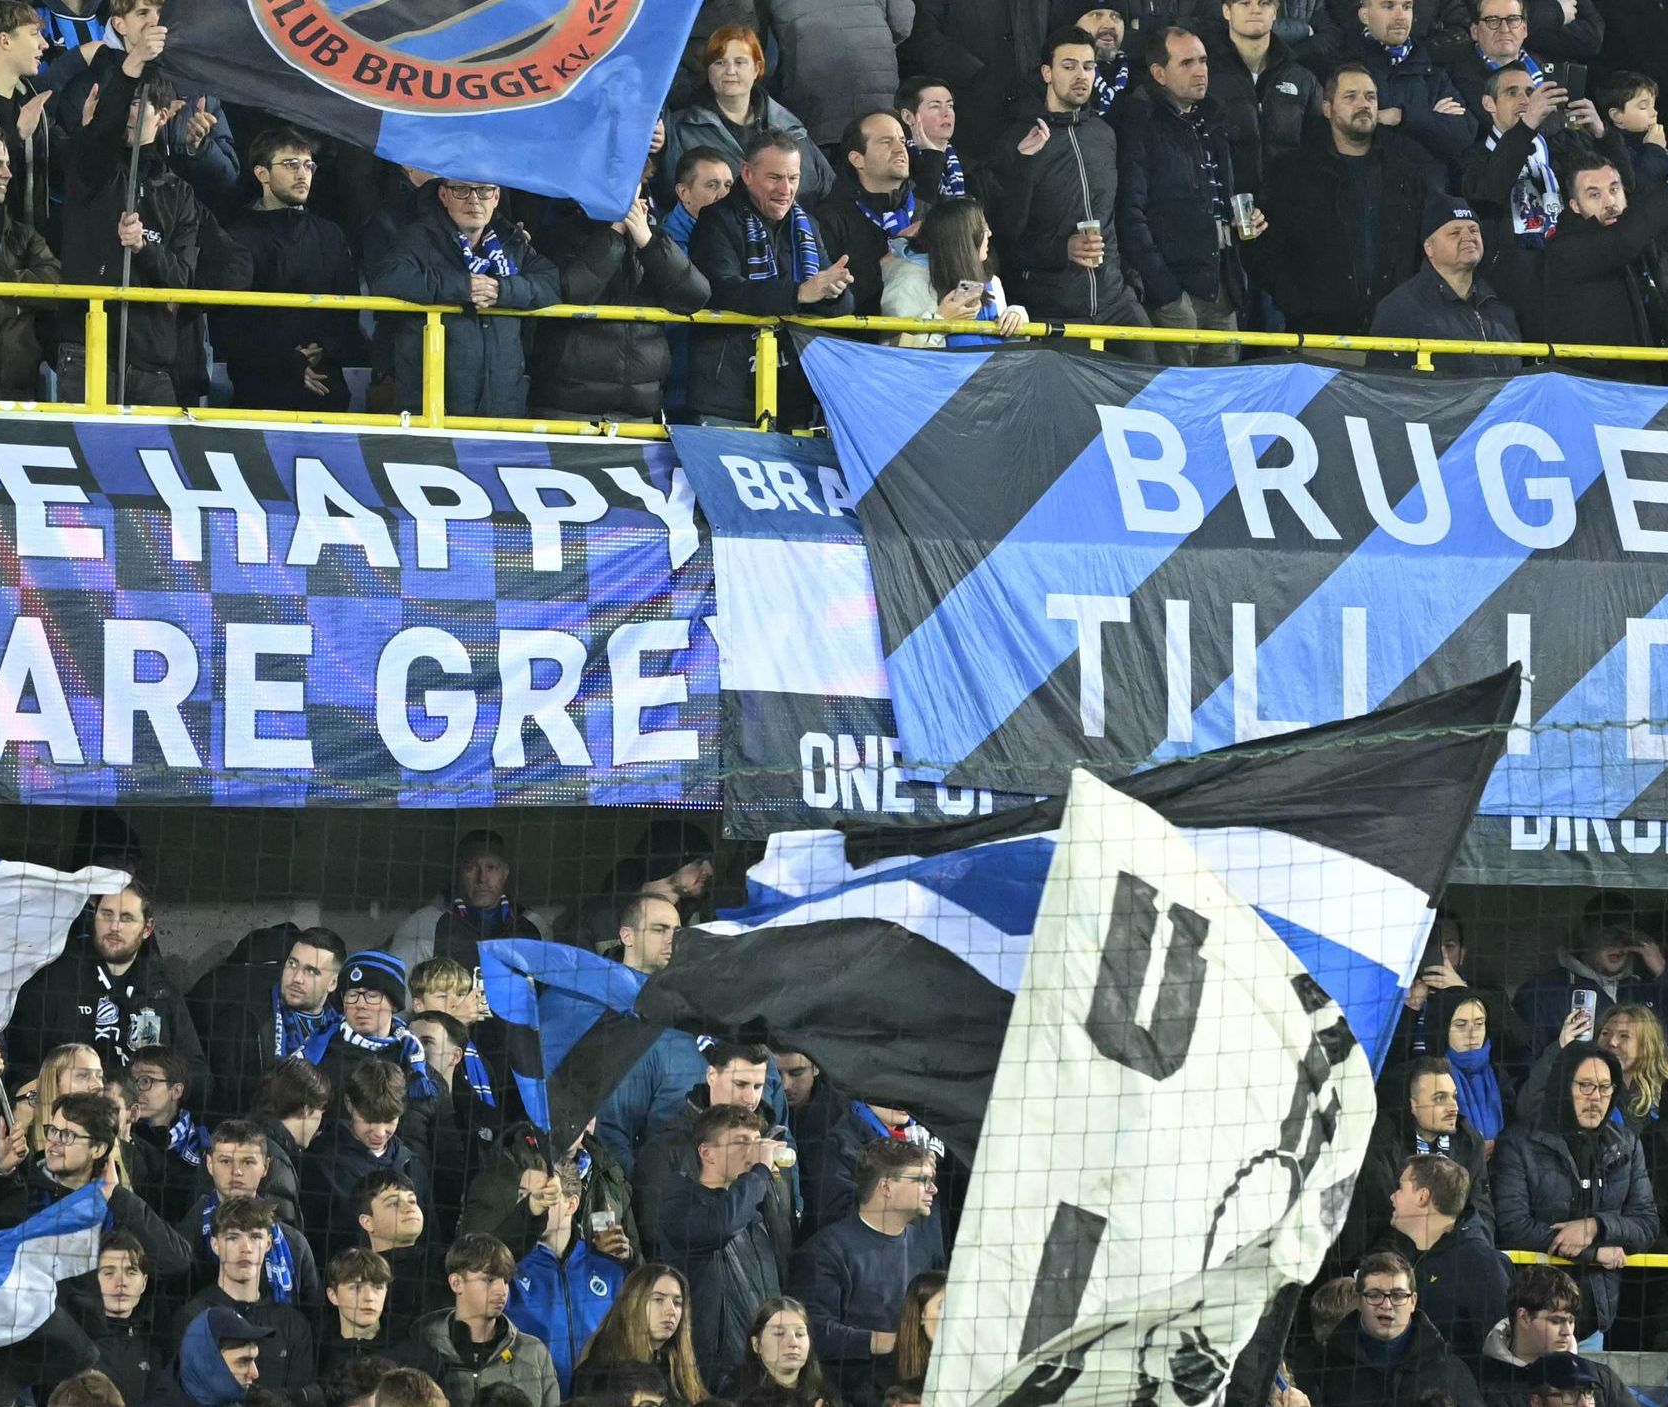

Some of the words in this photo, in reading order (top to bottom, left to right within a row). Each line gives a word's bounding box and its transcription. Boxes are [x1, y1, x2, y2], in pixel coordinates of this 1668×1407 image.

[352, 52, 552, 101] BRUGGE
[1453, 209, 1473, 218] 1891
[140, 448, 699, 571] HAPPY
[376, 620, 721, 770] GRE
[1506, 613, 1532, 754] I
[799, 731, 916, 813] ONE
